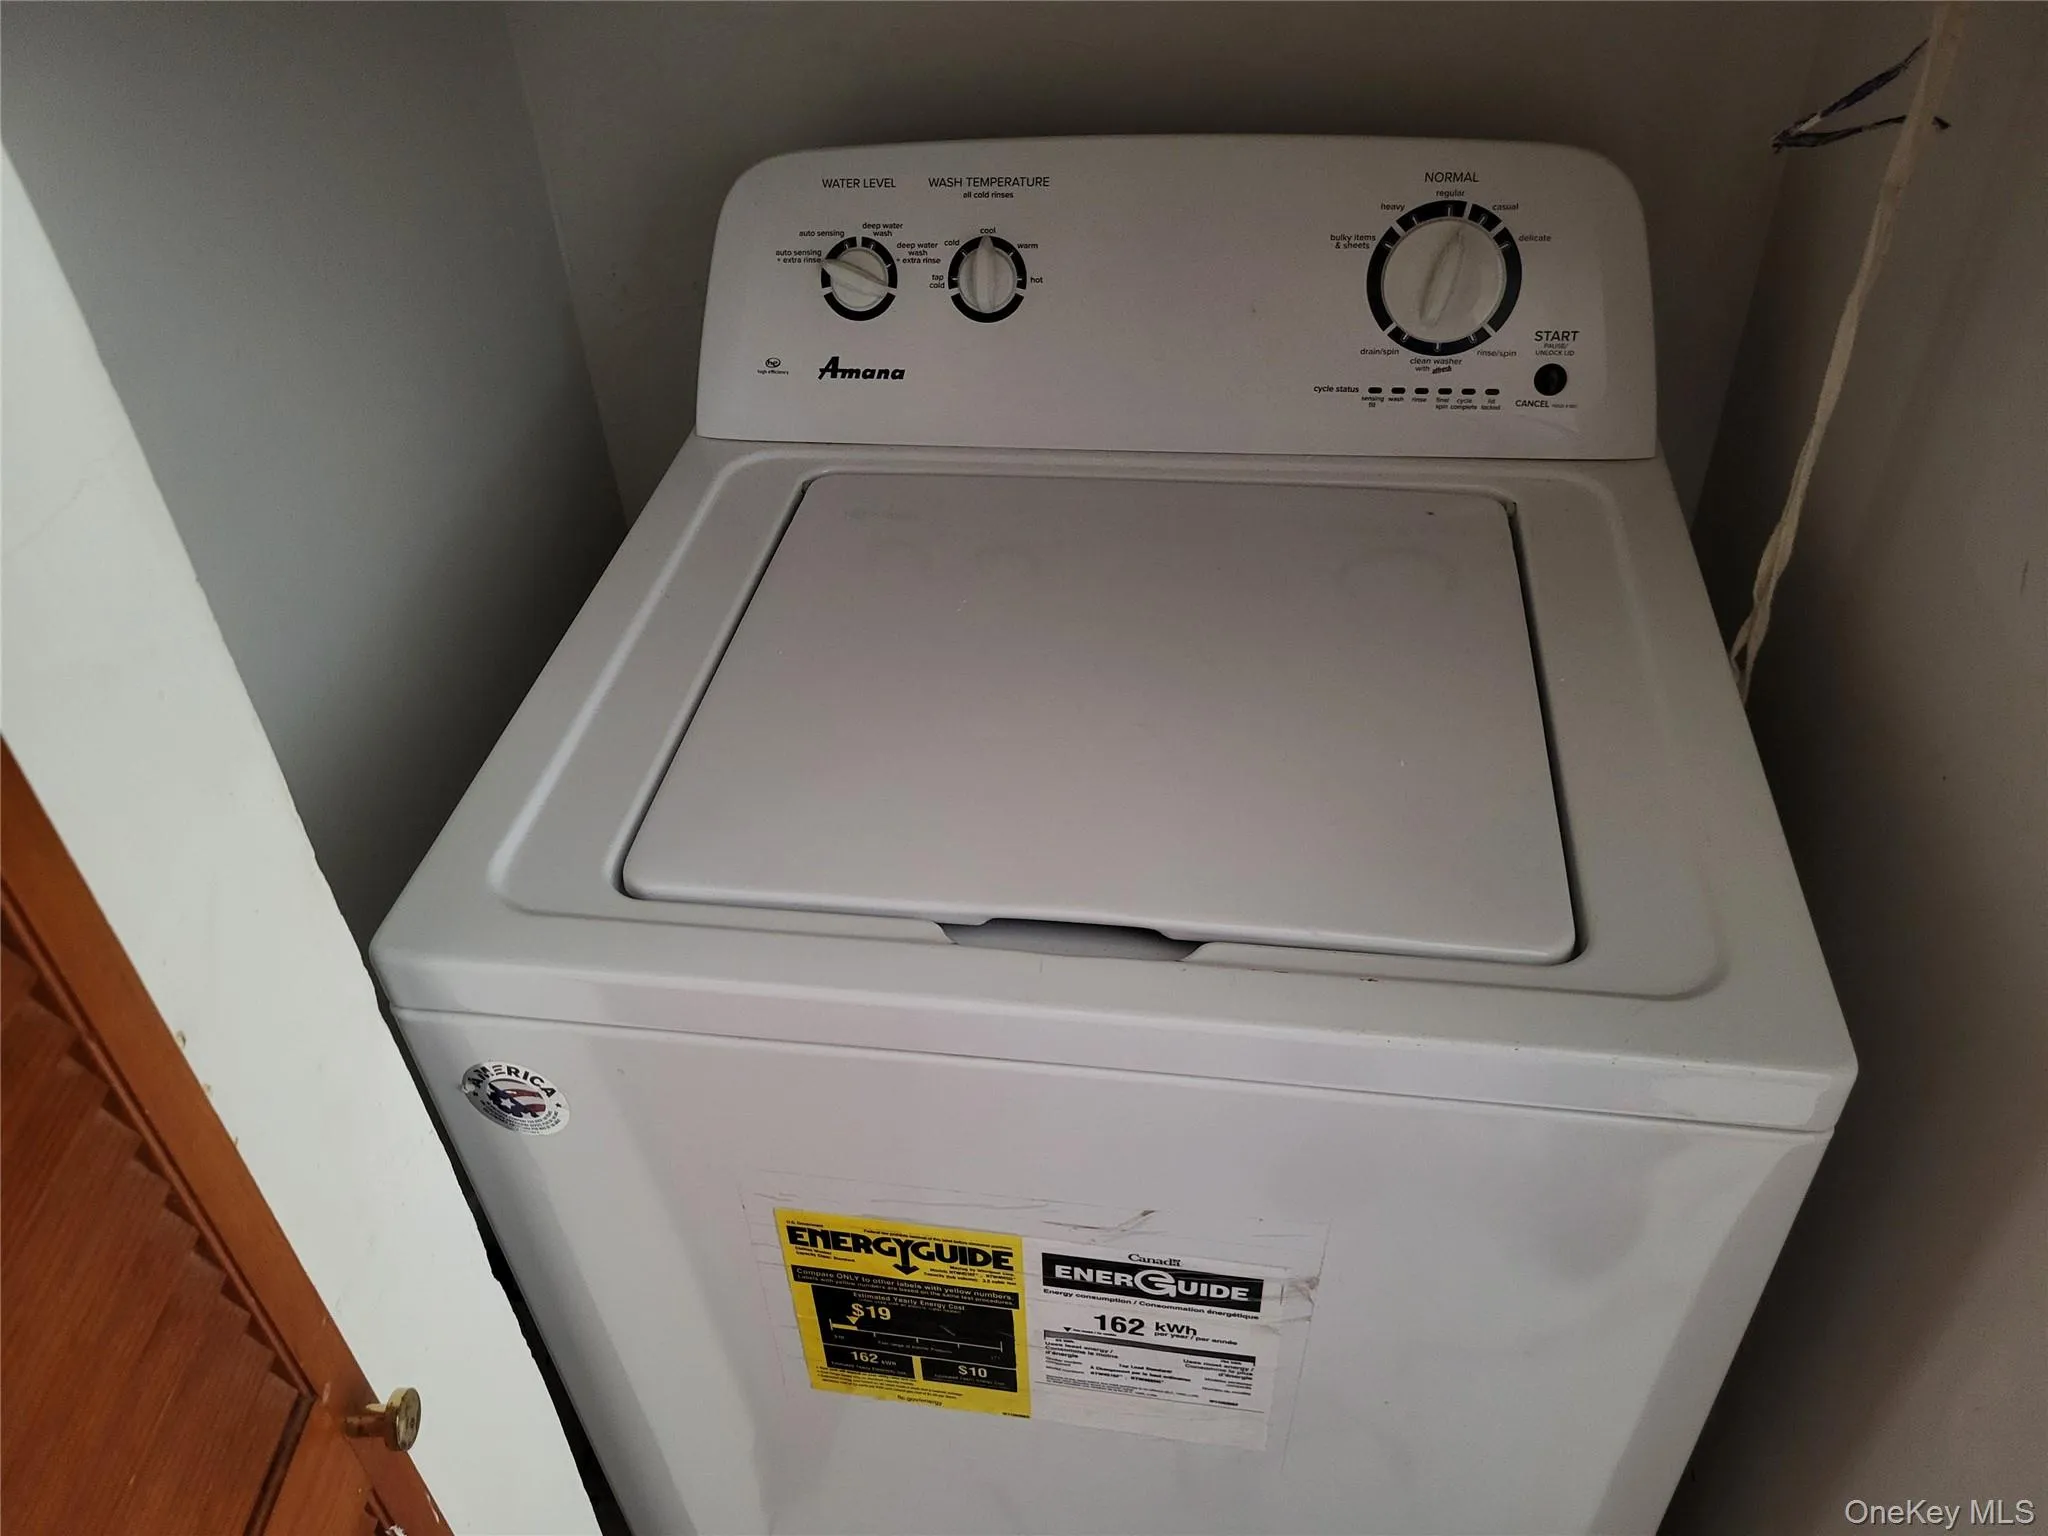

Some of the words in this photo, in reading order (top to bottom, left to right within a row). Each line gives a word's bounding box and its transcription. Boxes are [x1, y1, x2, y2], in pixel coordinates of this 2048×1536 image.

[929, 177, 963, 187] WASH
[966, 177, 1050, 187] TEMPERATURE
[1424, 172, 1480, 183] NORMAL
[822, 178, 860, 188] WATER
[863, 178, 896, 188] LEVEL
[963, 191, 972, 199] all
[973, 191, 990, 199] cold
[991, 191, 1014, 199] rinses
[1435, 189, 1465, 198] regular
[1381, 203, 1406, 212] heavy
[1492, 203, 1519, 211] casual
[862, 222, 881, 230] deep
[817, 230, 845, 238] sensing
[1330, 234, 1352, 243] bulky
[1354, 233, 1376, 242] items
[1518, 234, 1552, 242] delicate
[896, 241, 916, 249] deep
[944, 239, 960, 247] cold
[793, 249, 822, 257] sensing
[803, 256, 821, 264] rinse
[1030, 276, 1044, 284] hot
[929, 281, 945, 289] cold
[1534, 330, 1580, 342] START
[1360, 347, 1400, 356] drain/spin
[1476, 348, 1518, 357] rinse/spin
[1410, 357, 1431, 365] clean
[1432, 358, 1462, 366] washer
[818, 356, 906, 380] Amana
[1515, 399, 1550, 408] CANCEL
[468, 1065, 556, 1098] AMERICA
[786, 1225, 1014, 1273] ENERGYGUIDE
[1128, 1253, 1181, 1267] Canada
[796, 1267, 835, 1279] Compare
[836, 1271, 859, 1281] ONLY
[872, 1278, 895, 1286] other
[896, 1281, 922, 1290] labels
[924, 1284, 942, 1292] with
[944, 1286, 972, 1296] yellow
[857, 1282, 886, 1290] numbers
[1055, 1264, 1250, 1301] ENERGUIDE
[852, 1292, 891, 1302] Estimated
[893, 1296, 917, 1305] Yearly
[920, 1299, 946, 1309] Energy
[948, 1302, 965, 1311] Cost
[1043, 1288, 1073, 1298] Energy
[1075, 1293, 1132, 1305] consumption
[1139, 1301, 1205, 1314] Consommation
[1206, 1310, 1260, 1321] énergétique
[851, 1303, 892, 1321] $19
[1094, 1314, 1145, 1337] 162
[1155, 1321, 1197, 1336] kWh
[850, 1350, 879, 1364] 162
[957, 1365, 988, 1378] $10
